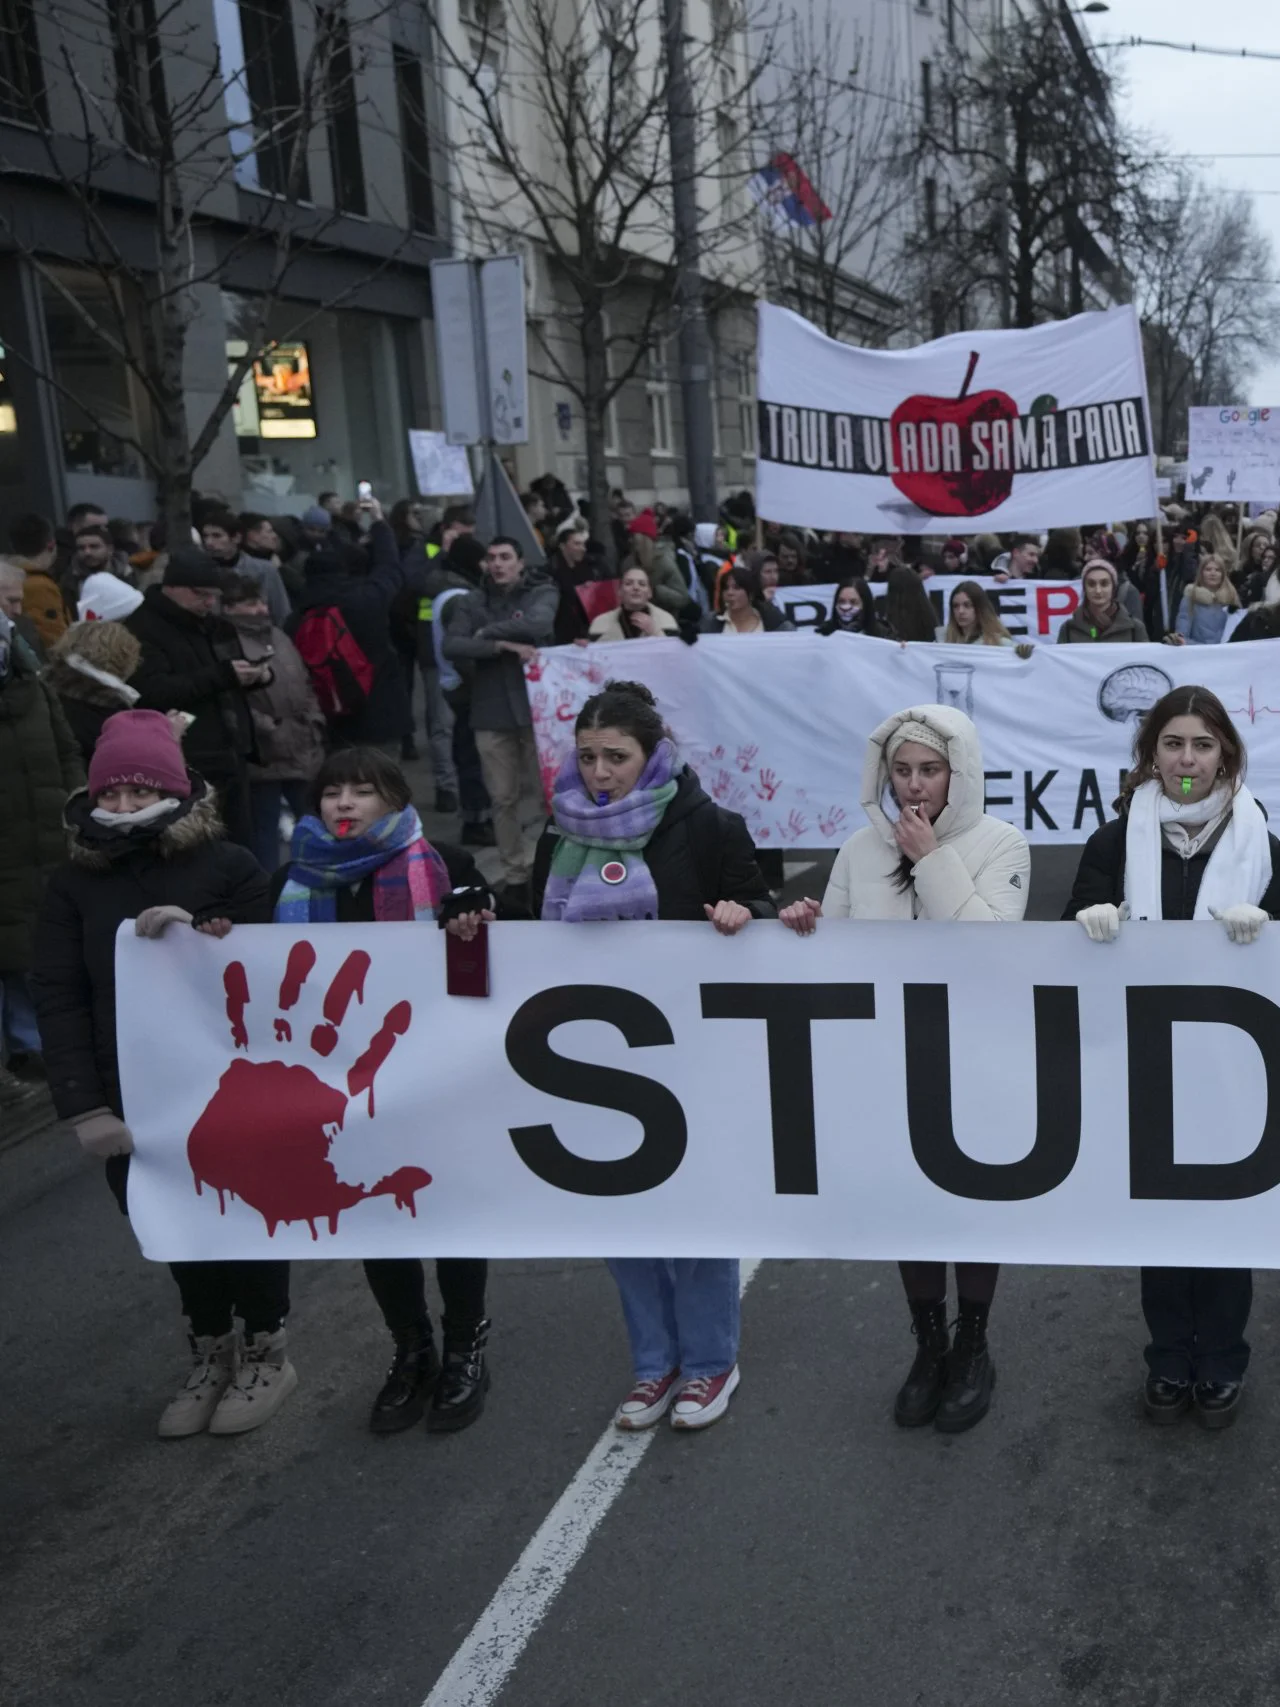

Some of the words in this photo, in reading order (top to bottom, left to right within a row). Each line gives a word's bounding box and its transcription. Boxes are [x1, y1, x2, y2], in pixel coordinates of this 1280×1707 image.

[766, 403, 853, 469] TRULA
[863, 410, 961, 473] VLADA
[972, 411, 1057, 472] SAMA
[1067, 401, 1142, 464] PADA
[1220, 408, 1271, 426] Google
